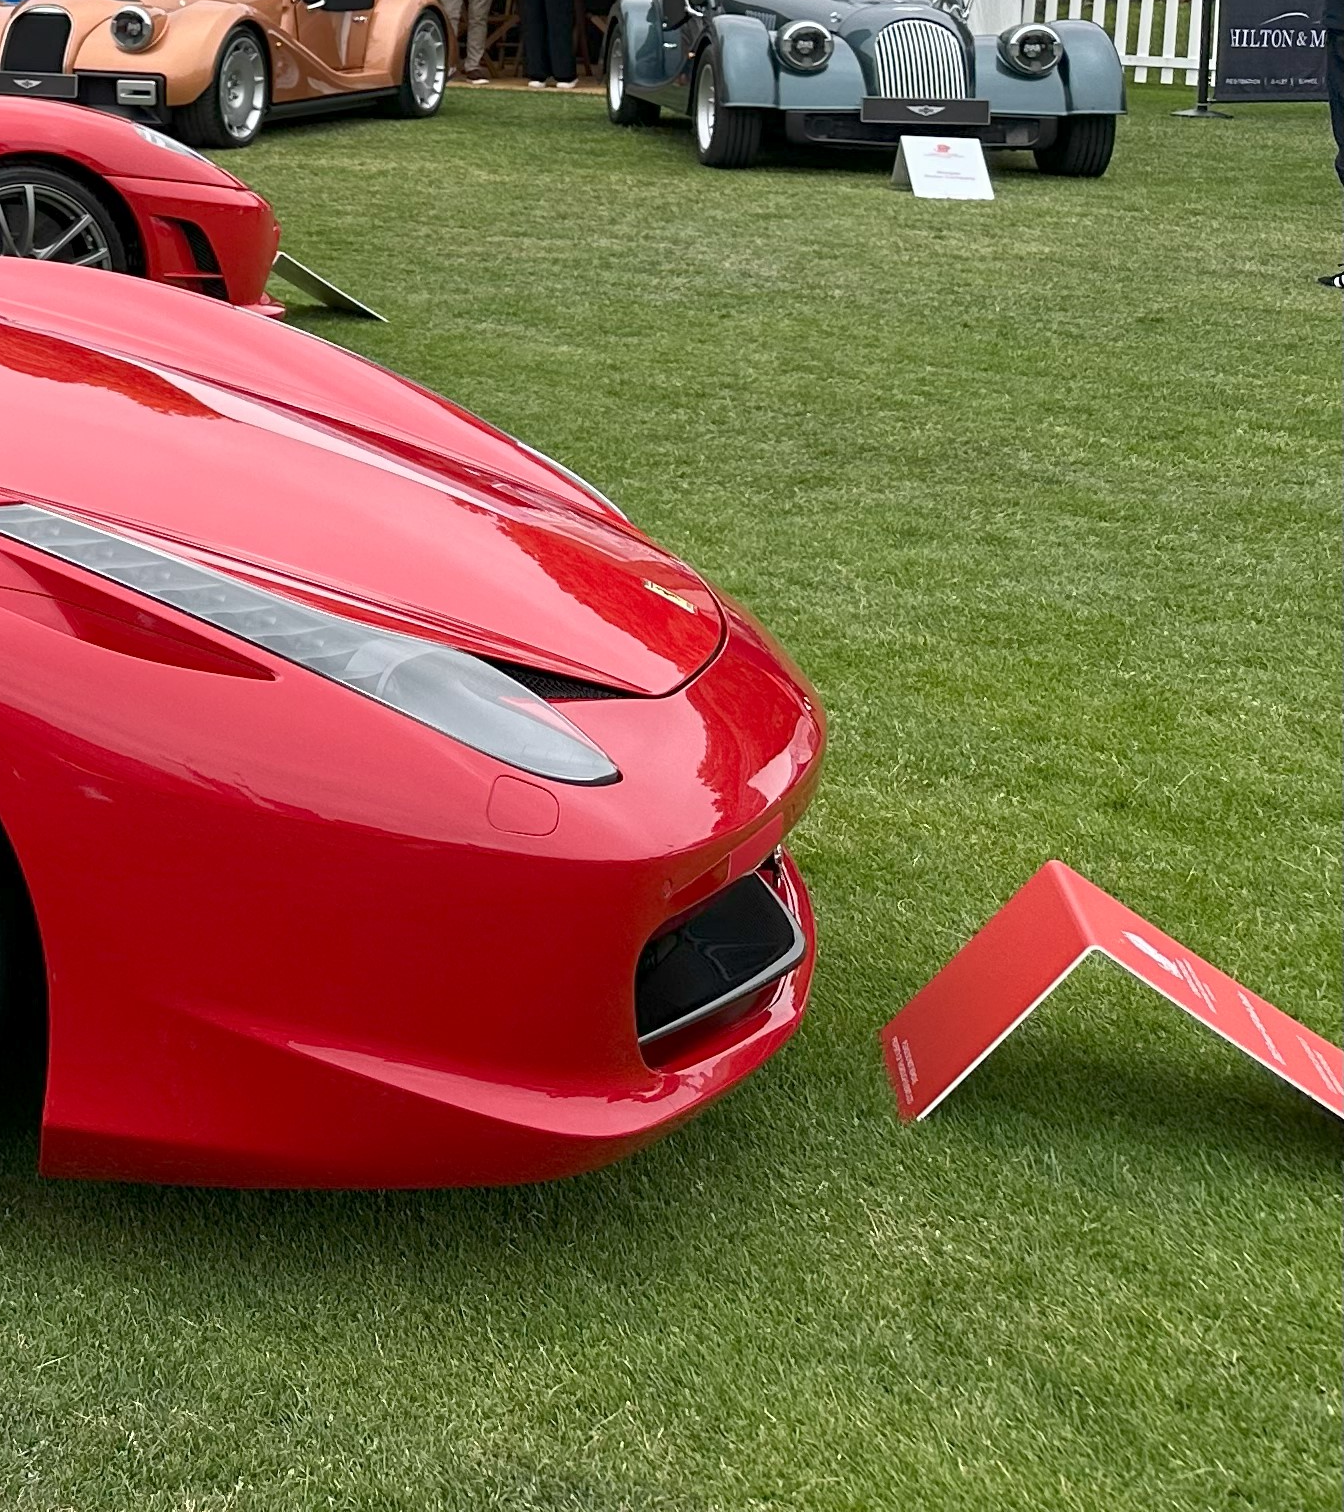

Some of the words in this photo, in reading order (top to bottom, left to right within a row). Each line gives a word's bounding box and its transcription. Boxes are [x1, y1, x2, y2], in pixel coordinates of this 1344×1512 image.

[1230, 29, 1295, 47] HILTON
[1296, 31, 1308, 47] &
[1310, 29, 1327, 48] M
